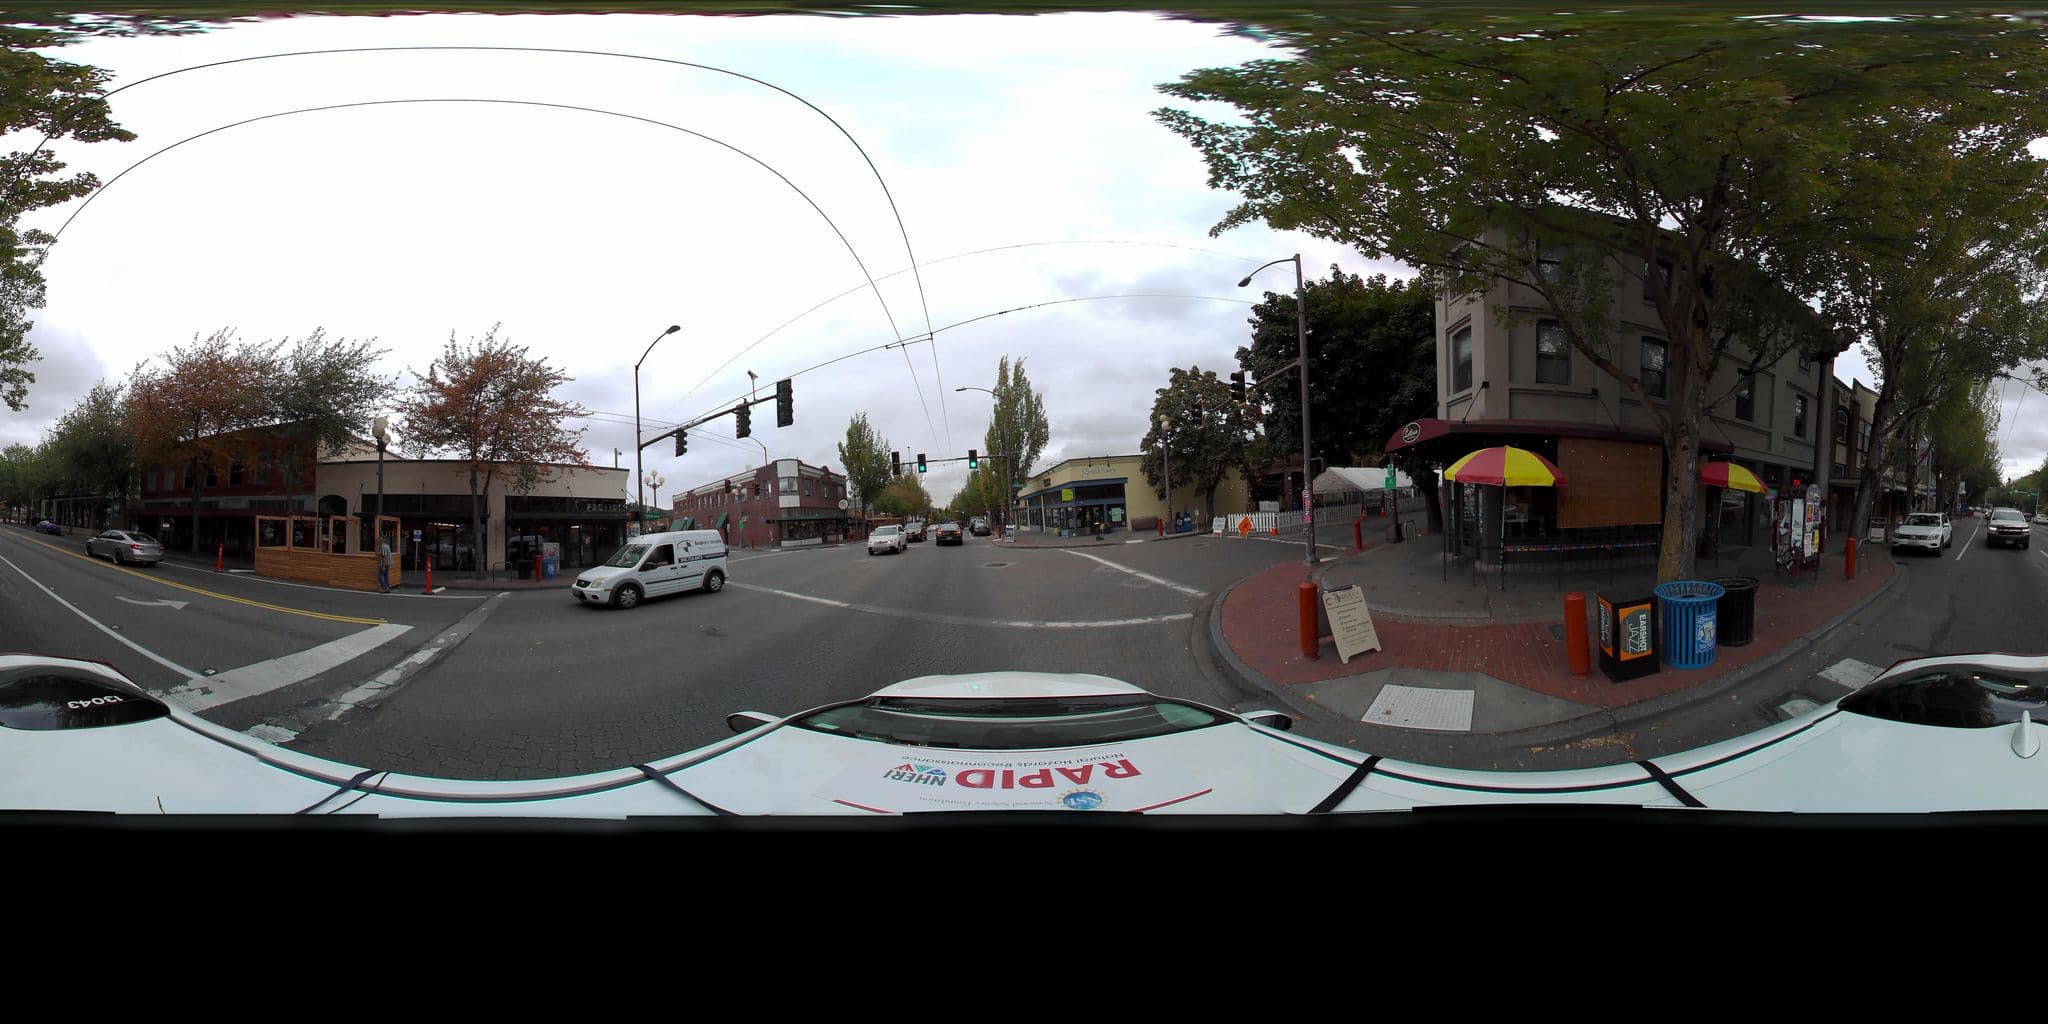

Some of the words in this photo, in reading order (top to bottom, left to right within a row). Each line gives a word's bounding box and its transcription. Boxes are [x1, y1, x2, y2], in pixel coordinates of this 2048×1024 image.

[1629, 623, 1640, 655] JAZZ
[1639, 614, 1648, 652] EARSHOT
[67, 695, 124, 709] 13043
[901, 755, 1012, 768] Reconnaissance
[1017, 759, 1072, 767] Hazards
[1076, 752, 1124, 764] Natural
[883, 769, 947, 786] NHERI
[955, 759, 1142, 789] RAPID
